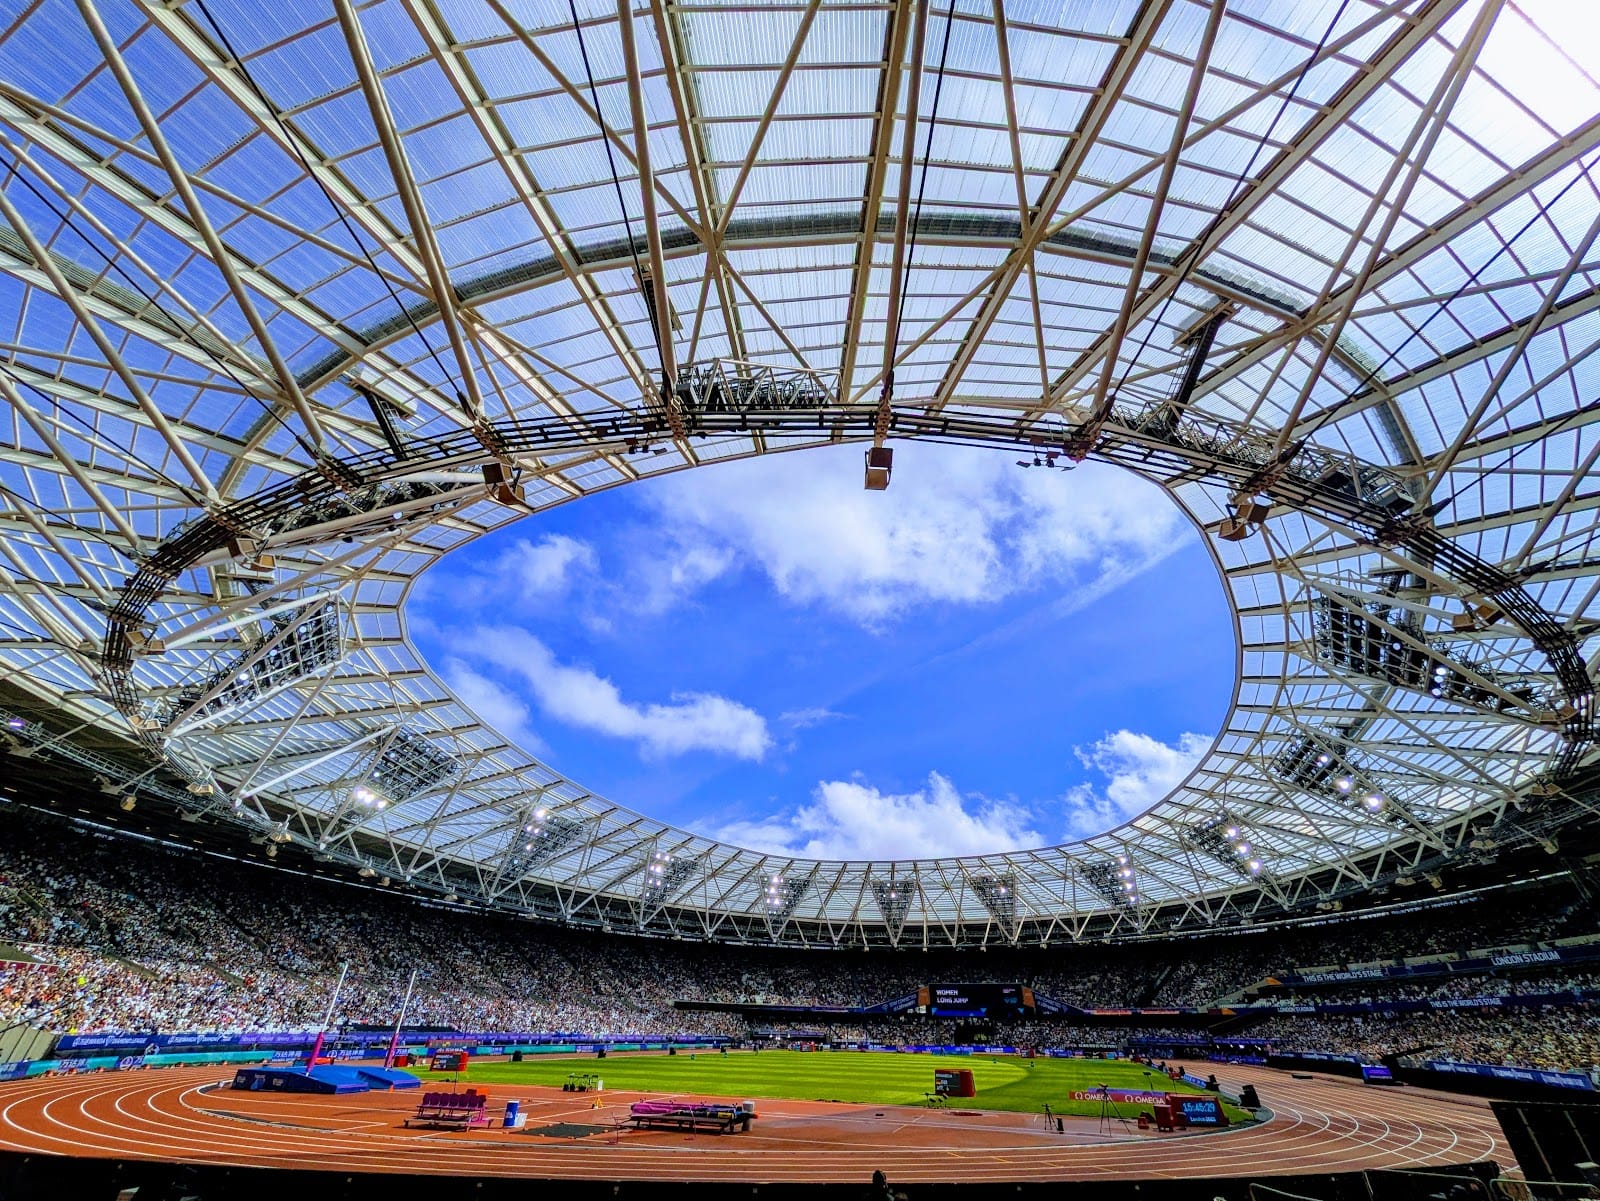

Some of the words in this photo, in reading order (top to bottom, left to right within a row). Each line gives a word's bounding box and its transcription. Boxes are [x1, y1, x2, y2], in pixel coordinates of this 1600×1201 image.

[1490, 954, 1524, 966] LONDON
[1523, 951, 1561, 963] STADIUM
[1302, 974, 1317, 983] THIS
[1323, 973, 1336, 981] THE
[1335, 970, 1363, 980] WORLD'S
[1362, 969, 1384, 978] STAGE
[1429, 1000, 1442, 1008] THIS
[1447, 999, 1459, 1007] THE
[1482, 997, 1503, 1006] STAGE
[1084, 1093, 1112, 1101] OMEGA
[1135, 1096, 1165, 1105] OMEGA
